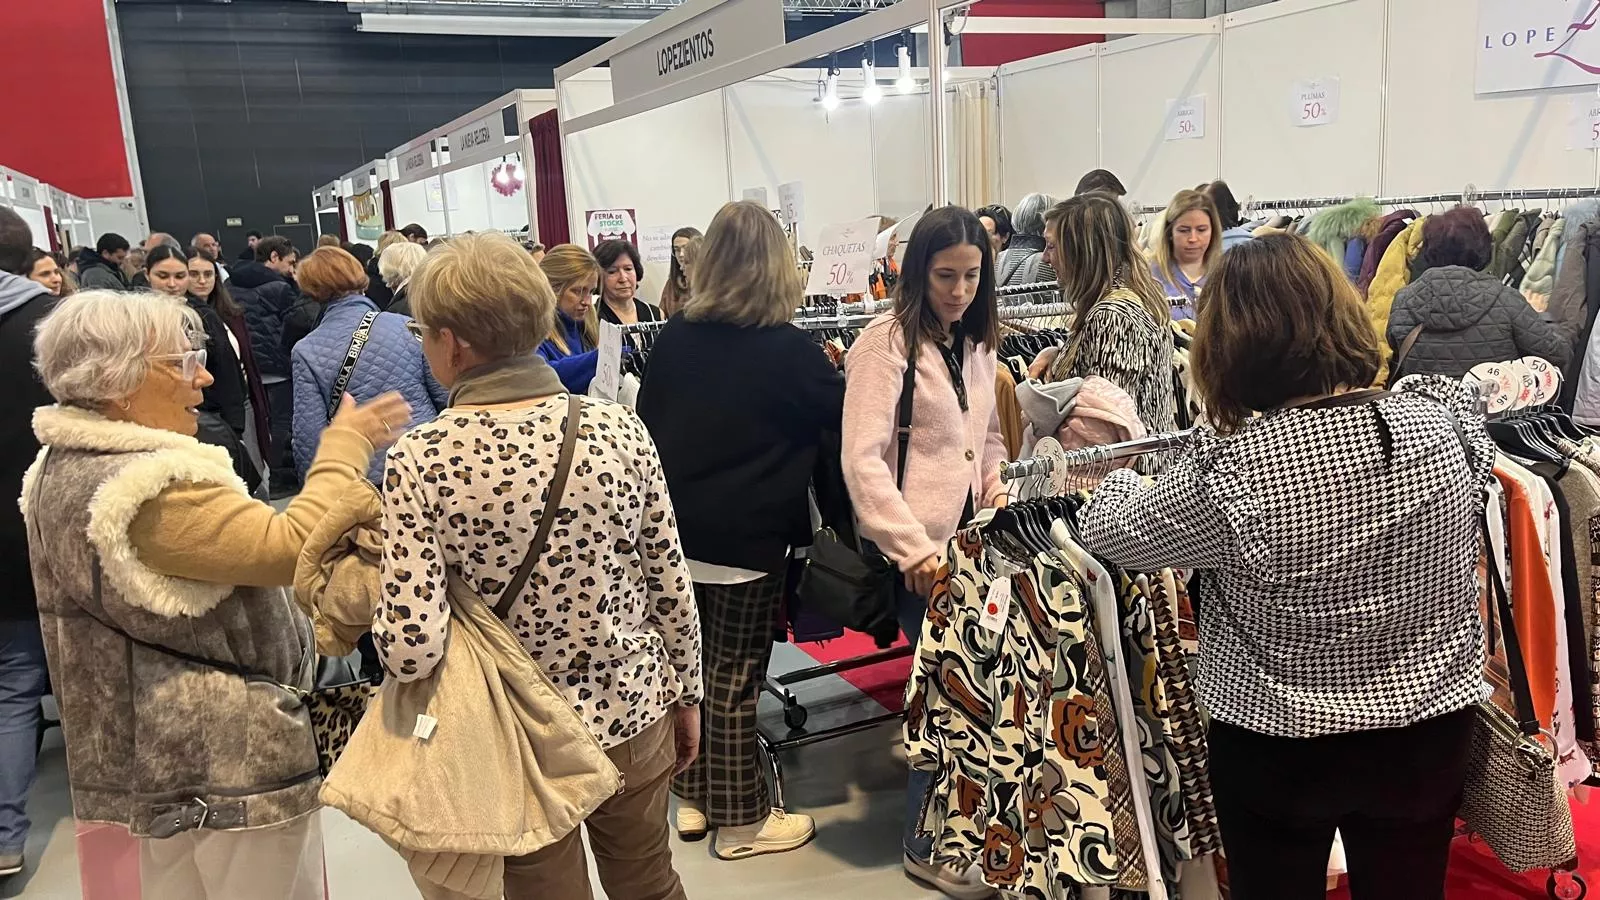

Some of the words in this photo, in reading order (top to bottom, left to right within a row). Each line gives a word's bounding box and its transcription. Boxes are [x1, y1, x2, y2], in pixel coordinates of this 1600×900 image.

[656, 28, 715, 76] LOPEZIENTOS
[822, 242, 866, 257] CHAQUETAS
[826, 262, 854, 286] 50%
[1487, 367, 1501, 376] 46
[1531, 360, 1547, 374] 50
